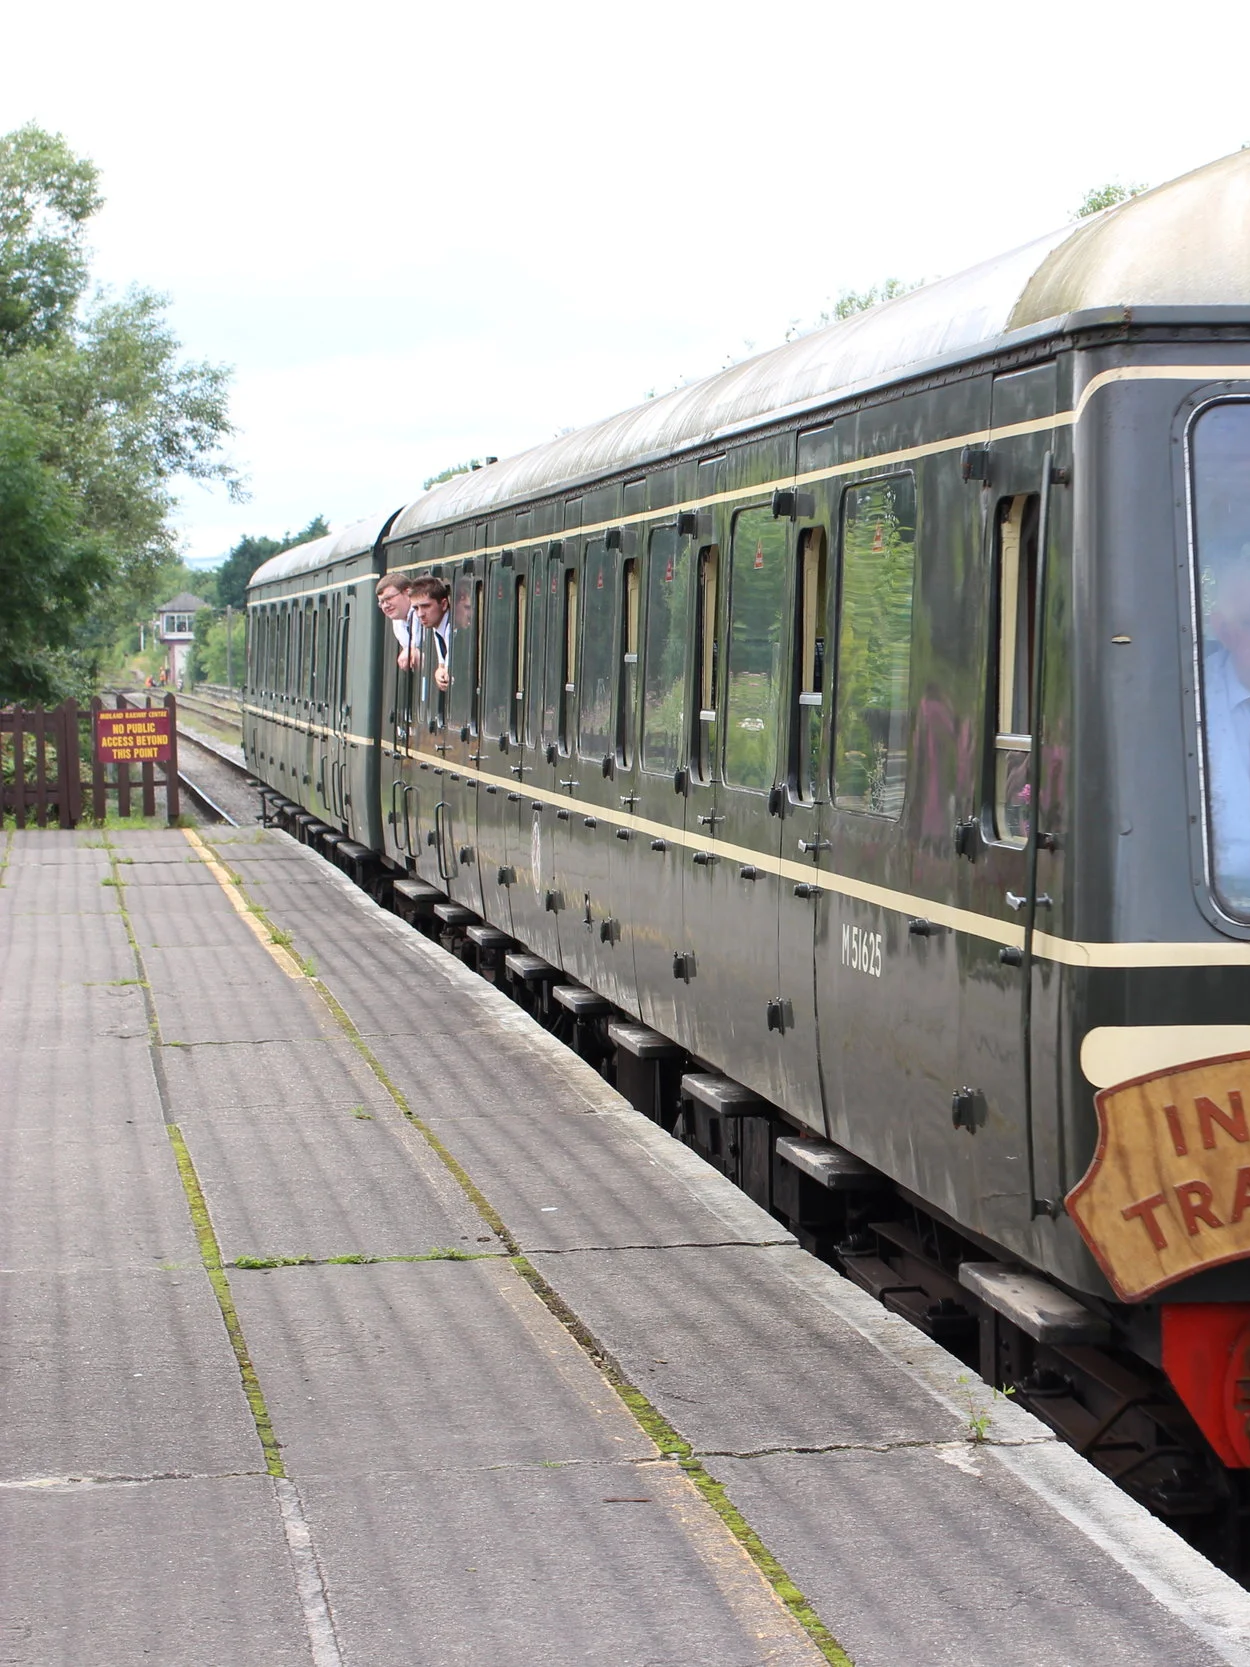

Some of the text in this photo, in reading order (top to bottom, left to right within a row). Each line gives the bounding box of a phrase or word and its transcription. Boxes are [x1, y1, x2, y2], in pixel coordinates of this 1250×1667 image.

[112, 722, 156, 734] NO PUBLIC
[102, 734, 168, 748] ACCESS BEYOND
[112, 748, 158, 759] THIS POINT
